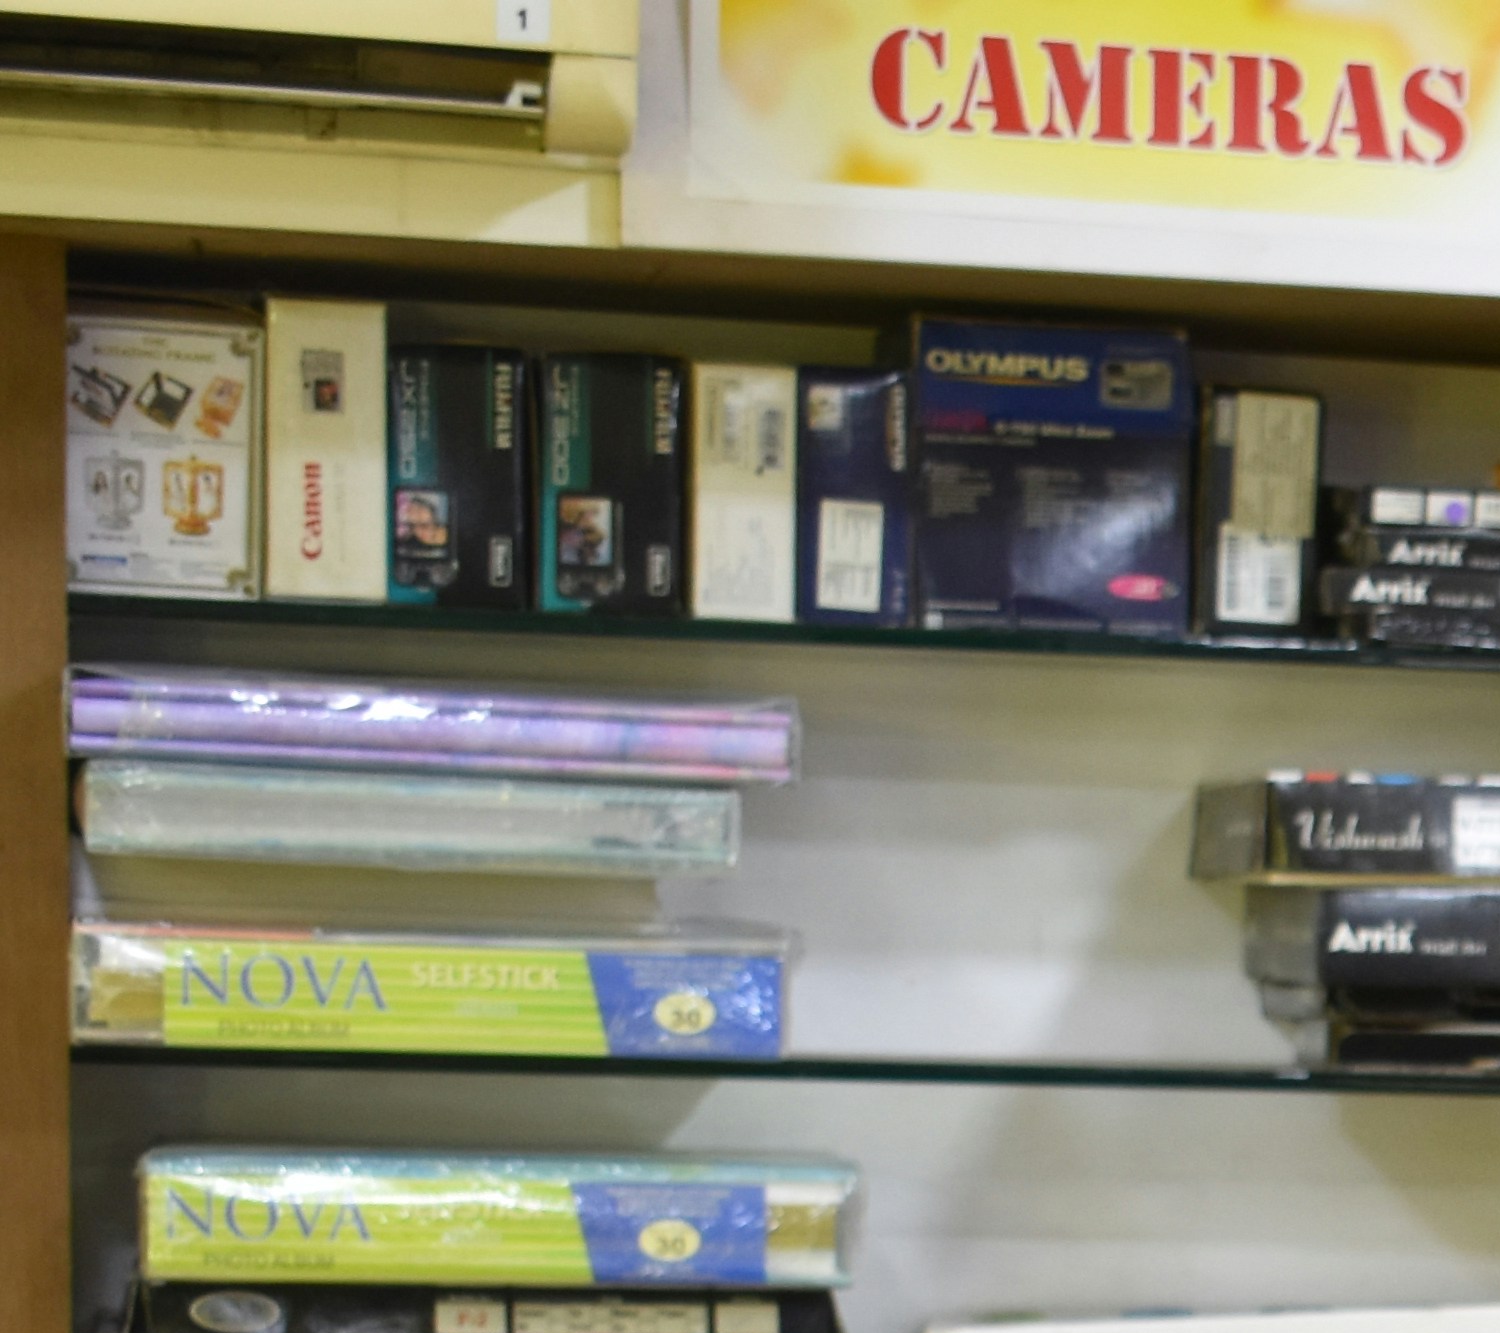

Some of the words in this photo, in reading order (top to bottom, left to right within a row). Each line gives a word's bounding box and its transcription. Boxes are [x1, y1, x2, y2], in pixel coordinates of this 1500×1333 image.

[516, 7, 528, 30] 1
[869, 28, 1469, 167] CAMERAS
[925, 349, 1089, 381] OLYMPUS
[301, 459, 322, 562] Canon
[1328, 920, 1417, 954] Arrix
[178, 951, 388, 1011] NOVA
[671, 1009, 702, 1028] 30
[164, 1186, 373, 1244] NOVA
[656, 1234, 687, 1255] 30
